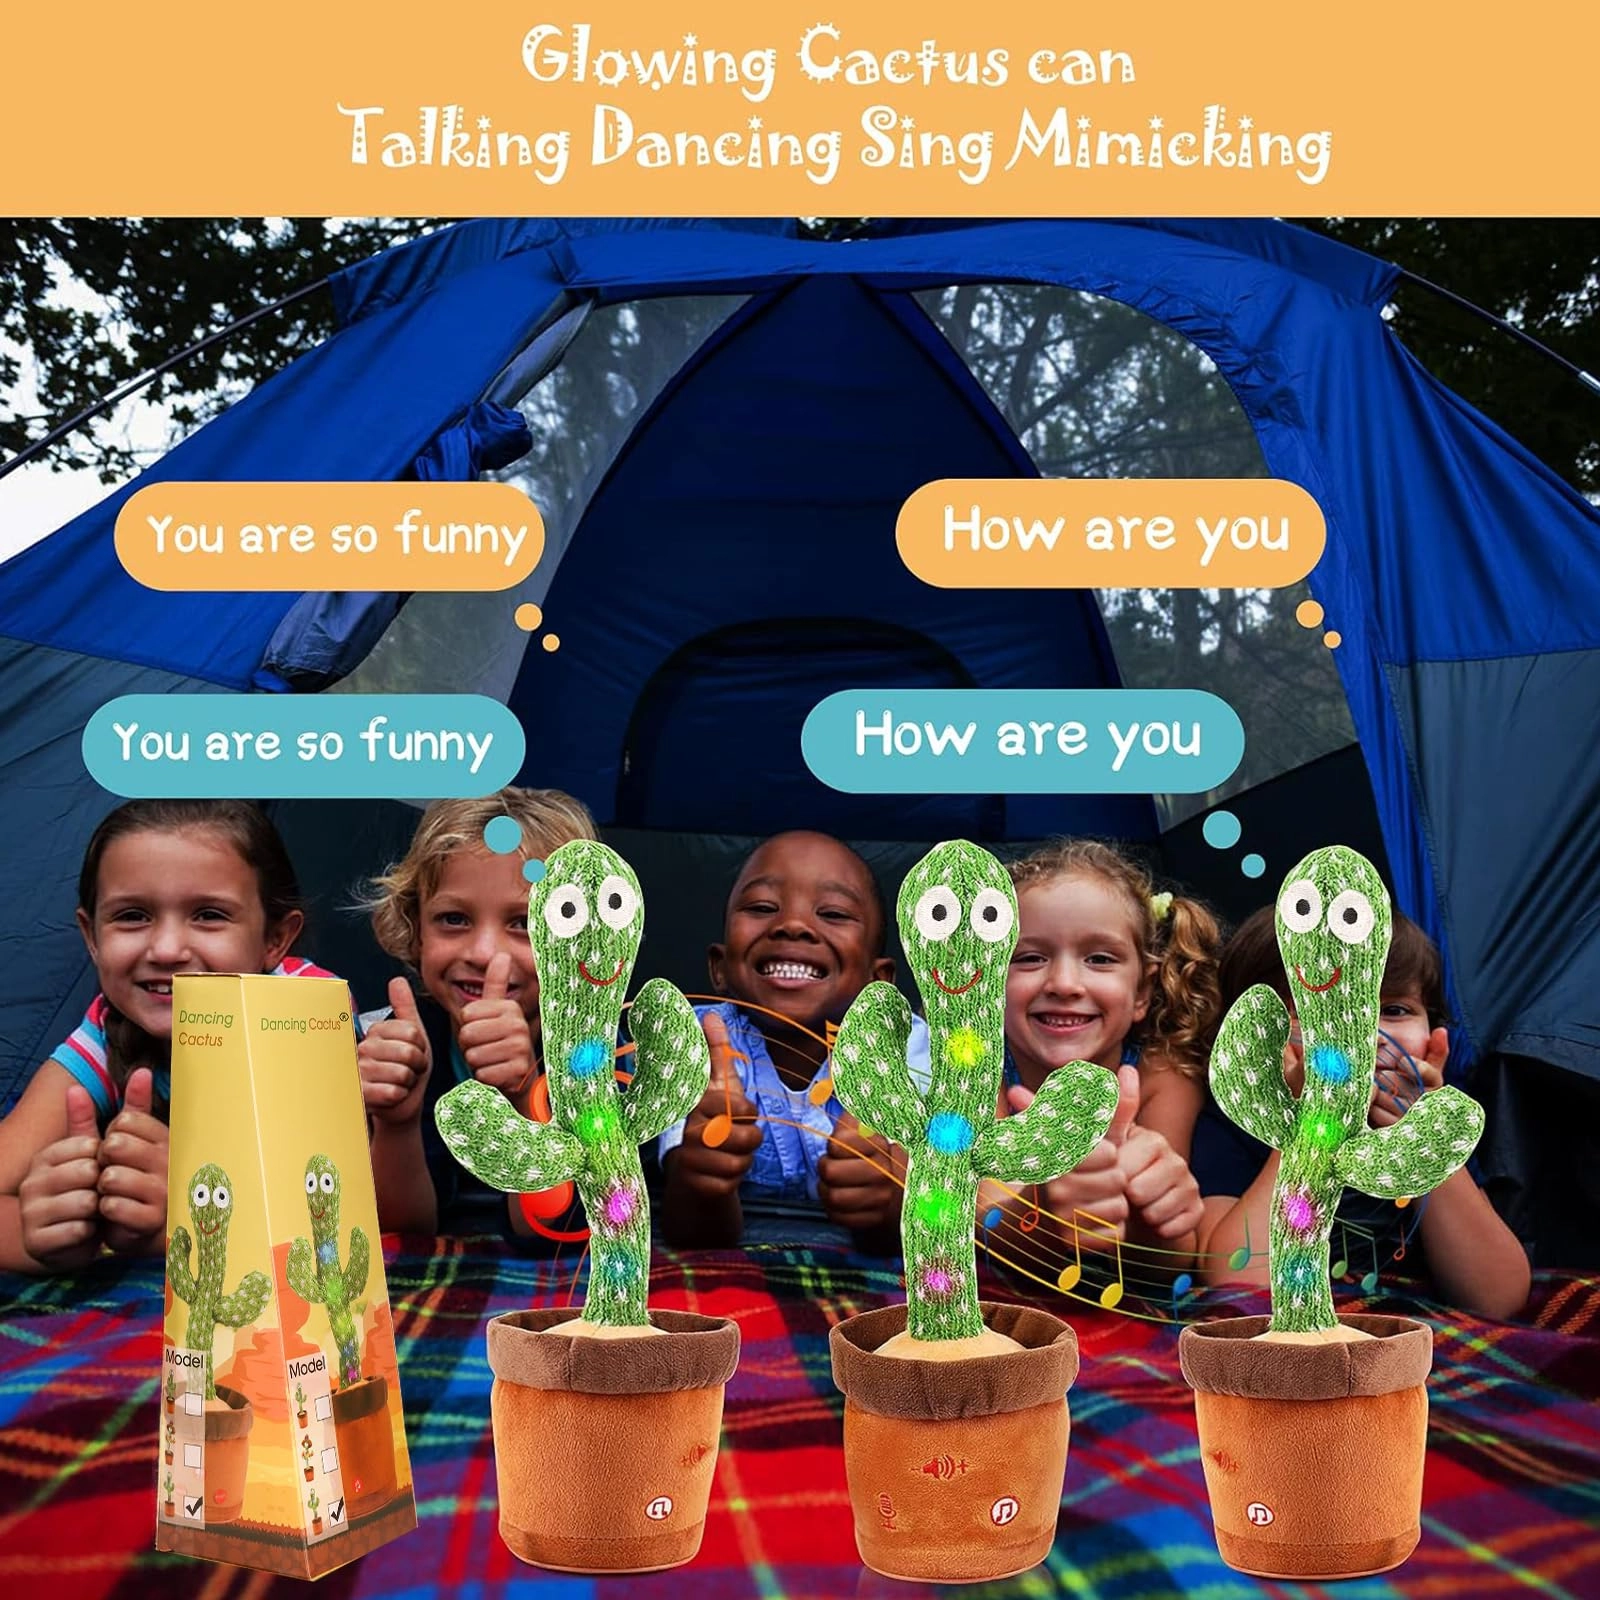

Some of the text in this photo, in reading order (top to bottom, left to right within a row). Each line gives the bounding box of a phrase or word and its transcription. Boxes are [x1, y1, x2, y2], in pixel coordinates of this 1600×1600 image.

[179, 1010, 234, 1029] Dancing
[261, 1018, 307, 1034] Dancing
[178, 1032, 223, 1047] Cactus
[165, 1348, 204, 1369] Model
[289, 1355, 326, 1379] Model
